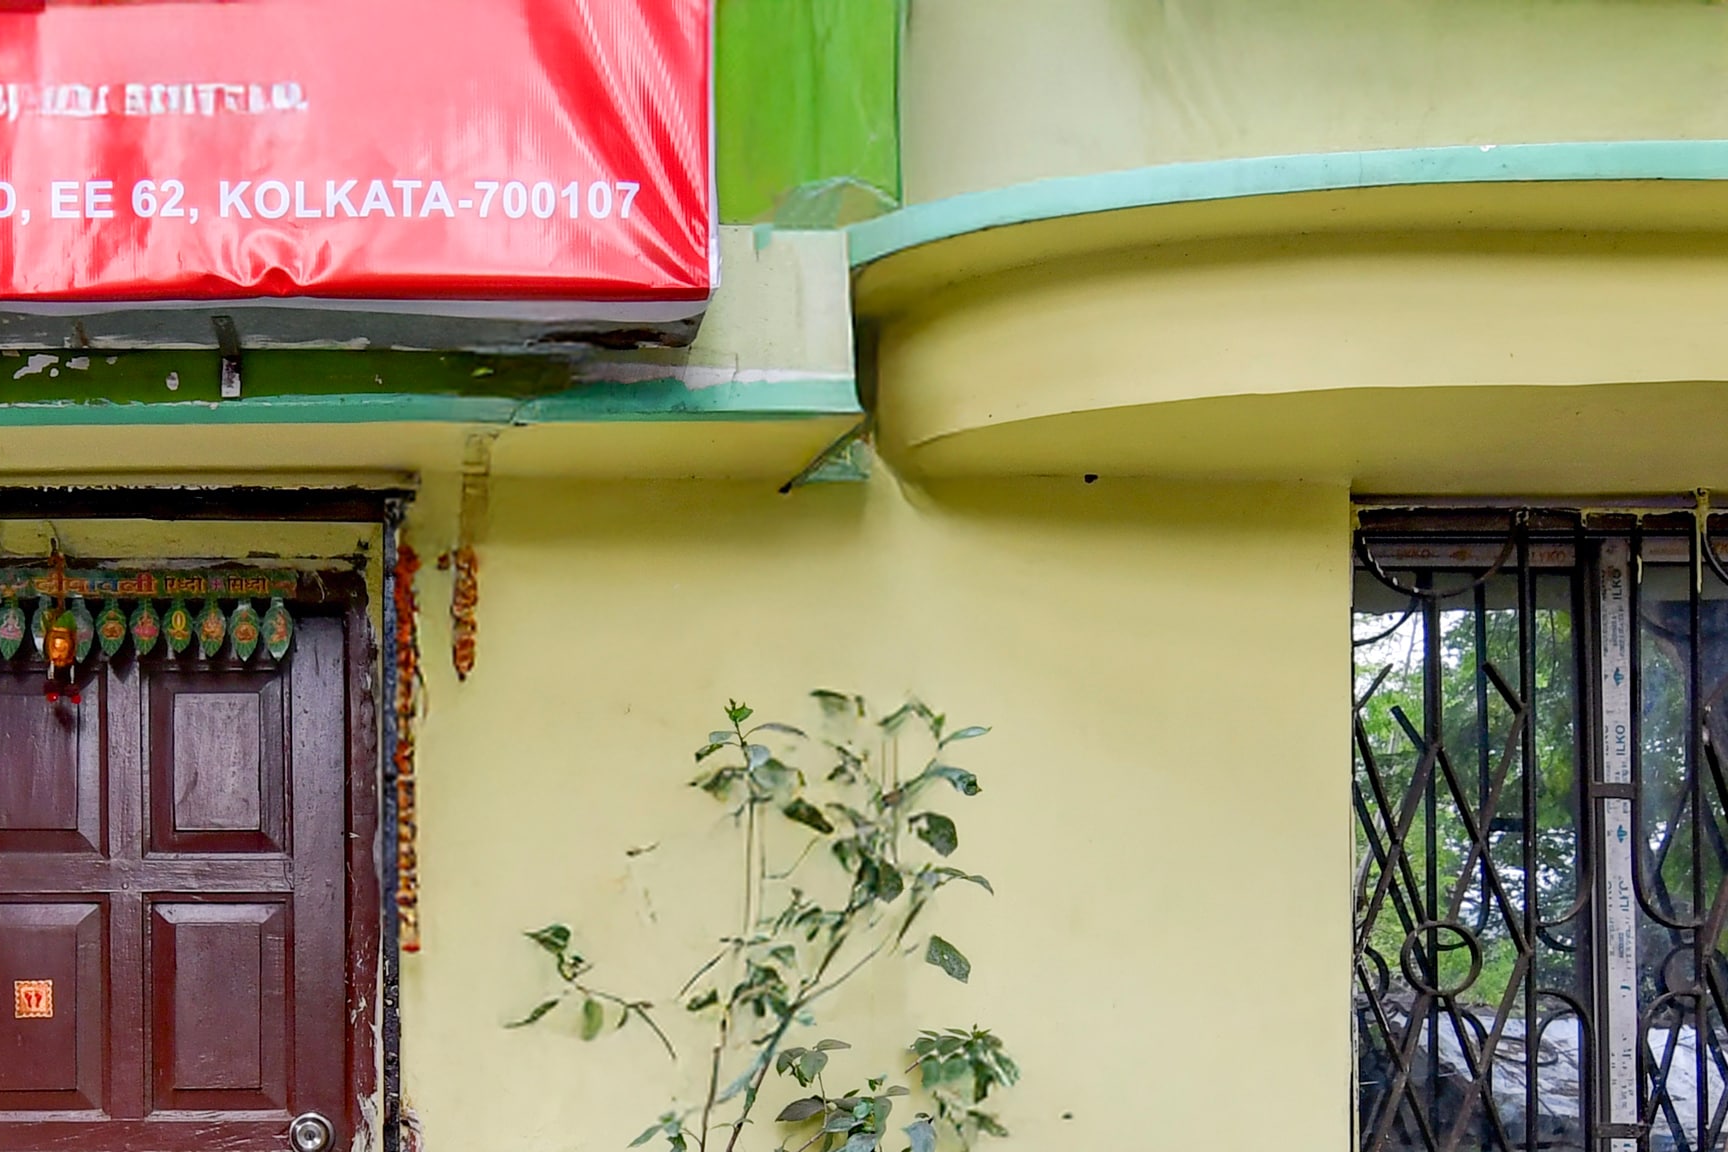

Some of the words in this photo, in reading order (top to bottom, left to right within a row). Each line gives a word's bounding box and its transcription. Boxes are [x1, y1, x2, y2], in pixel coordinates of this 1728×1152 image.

[51, 180, 114, 218] EE
[132, 180, 199, 224] 62,
[219, 180, 640, 219] KOLKATA-700107
[1615, 724, 1626, 756] ILKO
